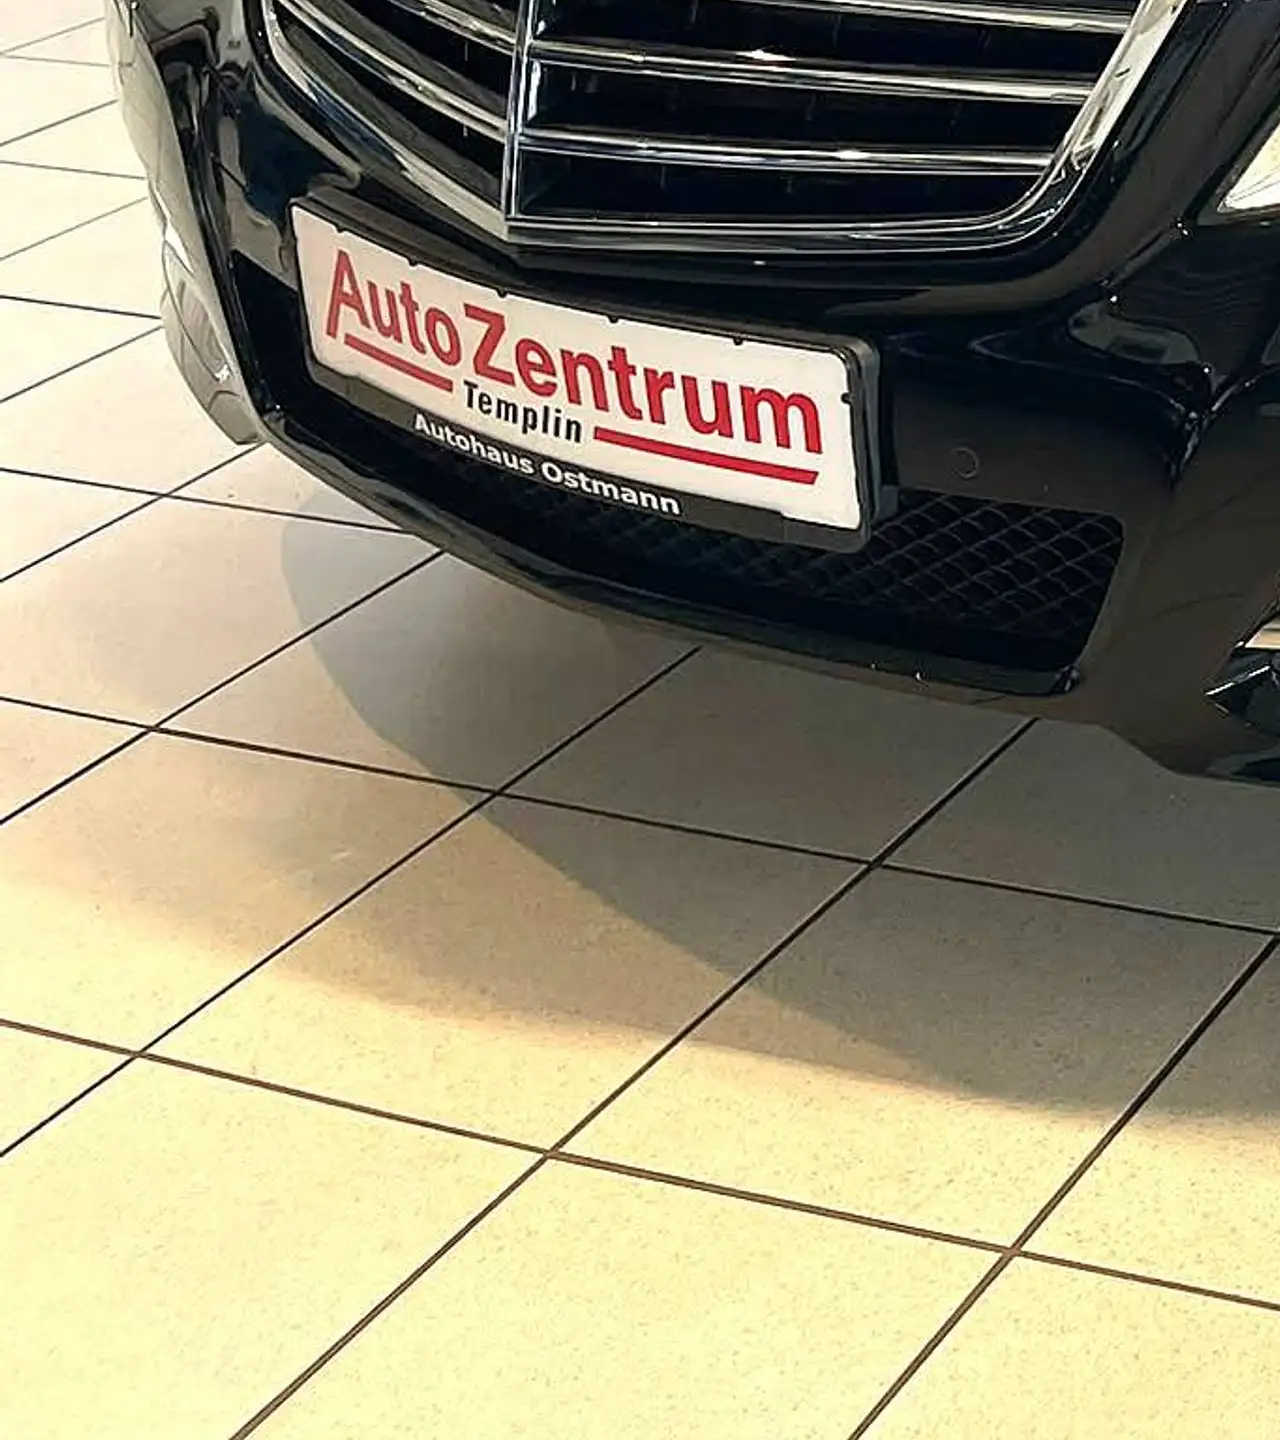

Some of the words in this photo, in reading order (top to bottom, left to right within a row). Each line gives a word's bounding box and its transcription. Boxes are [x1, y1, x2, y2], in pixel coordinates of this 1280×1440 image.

[326, 249, 462, 366] Auto
[464, 302, 823, 454] Zentrum
[463, 379, 583, 444] Templin
[413, 413, 535, 475] Autohaus
[542, 461, 682, 516] Ostmann
